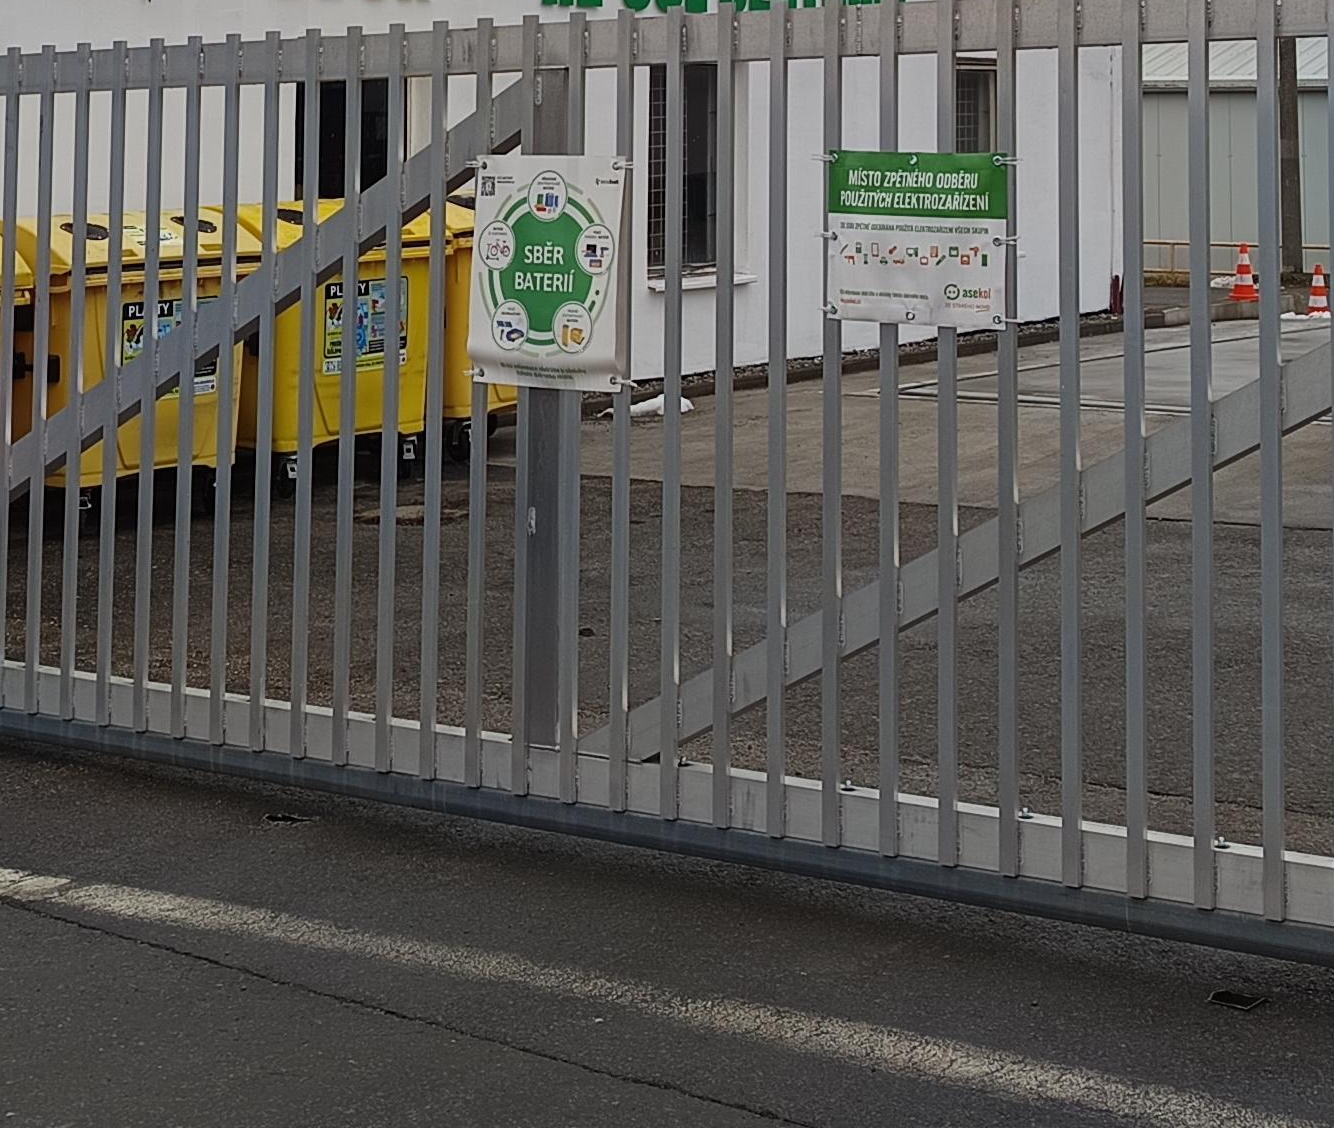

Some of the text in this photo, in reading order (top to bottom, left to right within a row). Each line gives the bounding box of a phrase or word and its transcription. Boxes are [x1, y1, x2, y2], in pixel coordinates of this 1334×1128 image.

[848, 167, 978, 189] MÍSTO ZPĚTNÉHO ODBĚRU
[840, 189, 989, 211] POUŽITÝCH ELEKTROZAŘÍZENÍ
[524, 241, 564, 265] SBĚR
[514, 269, 575, 293] BATERIÍ
[962, 288, 991, 300] asekol
